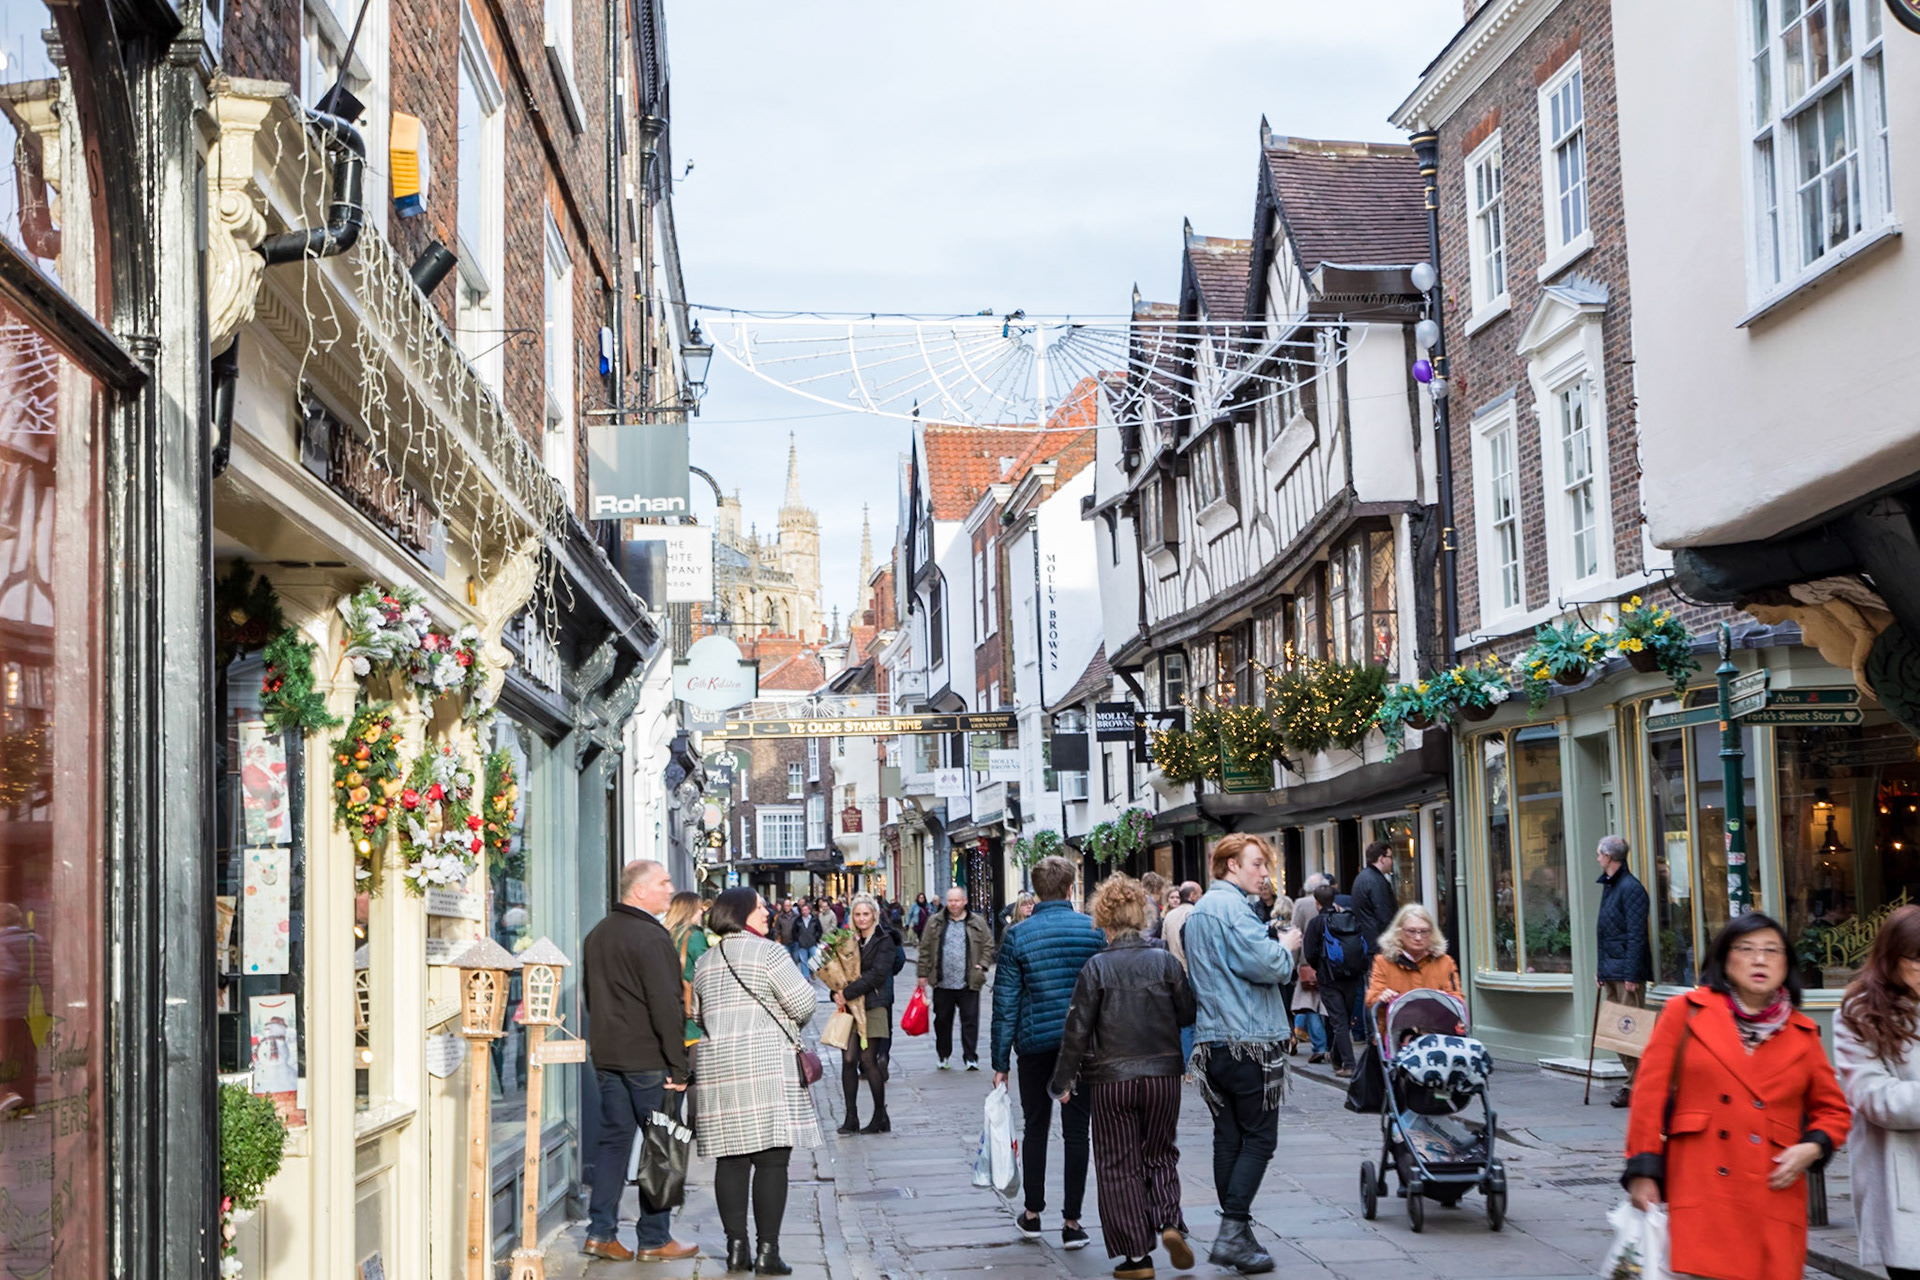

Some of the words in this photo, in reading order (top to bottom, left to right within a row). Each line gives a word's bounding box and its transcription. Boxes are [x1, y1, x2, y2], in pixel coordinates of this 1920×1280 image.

[595, 494, 685, 514] Rohan
[667, 540, 685, 550] HE
[667, 553, 693, 562] HITE
[666, 565, 703, 575] PANY
[1046, 554, 1056, 604] MOLLY
[1048, 610, 1059, 671] BROWNS
[1776, 692, 1800, 702] Area
[1096, 712, 1128, 720] MOLLY
[1779, 710, 1810, 721] Sweet
[1812, 711, 1841, 723] Story
[788, 722, 805, 734] YE
[807, 721, 842, 733] OLDE
[844, 720, 891, 732] STARRE
[893, 719, 923, 731] INNE
[1096, 720, 1135, 728] BROWNS
[1819, 886, 1914, 971] Botant
